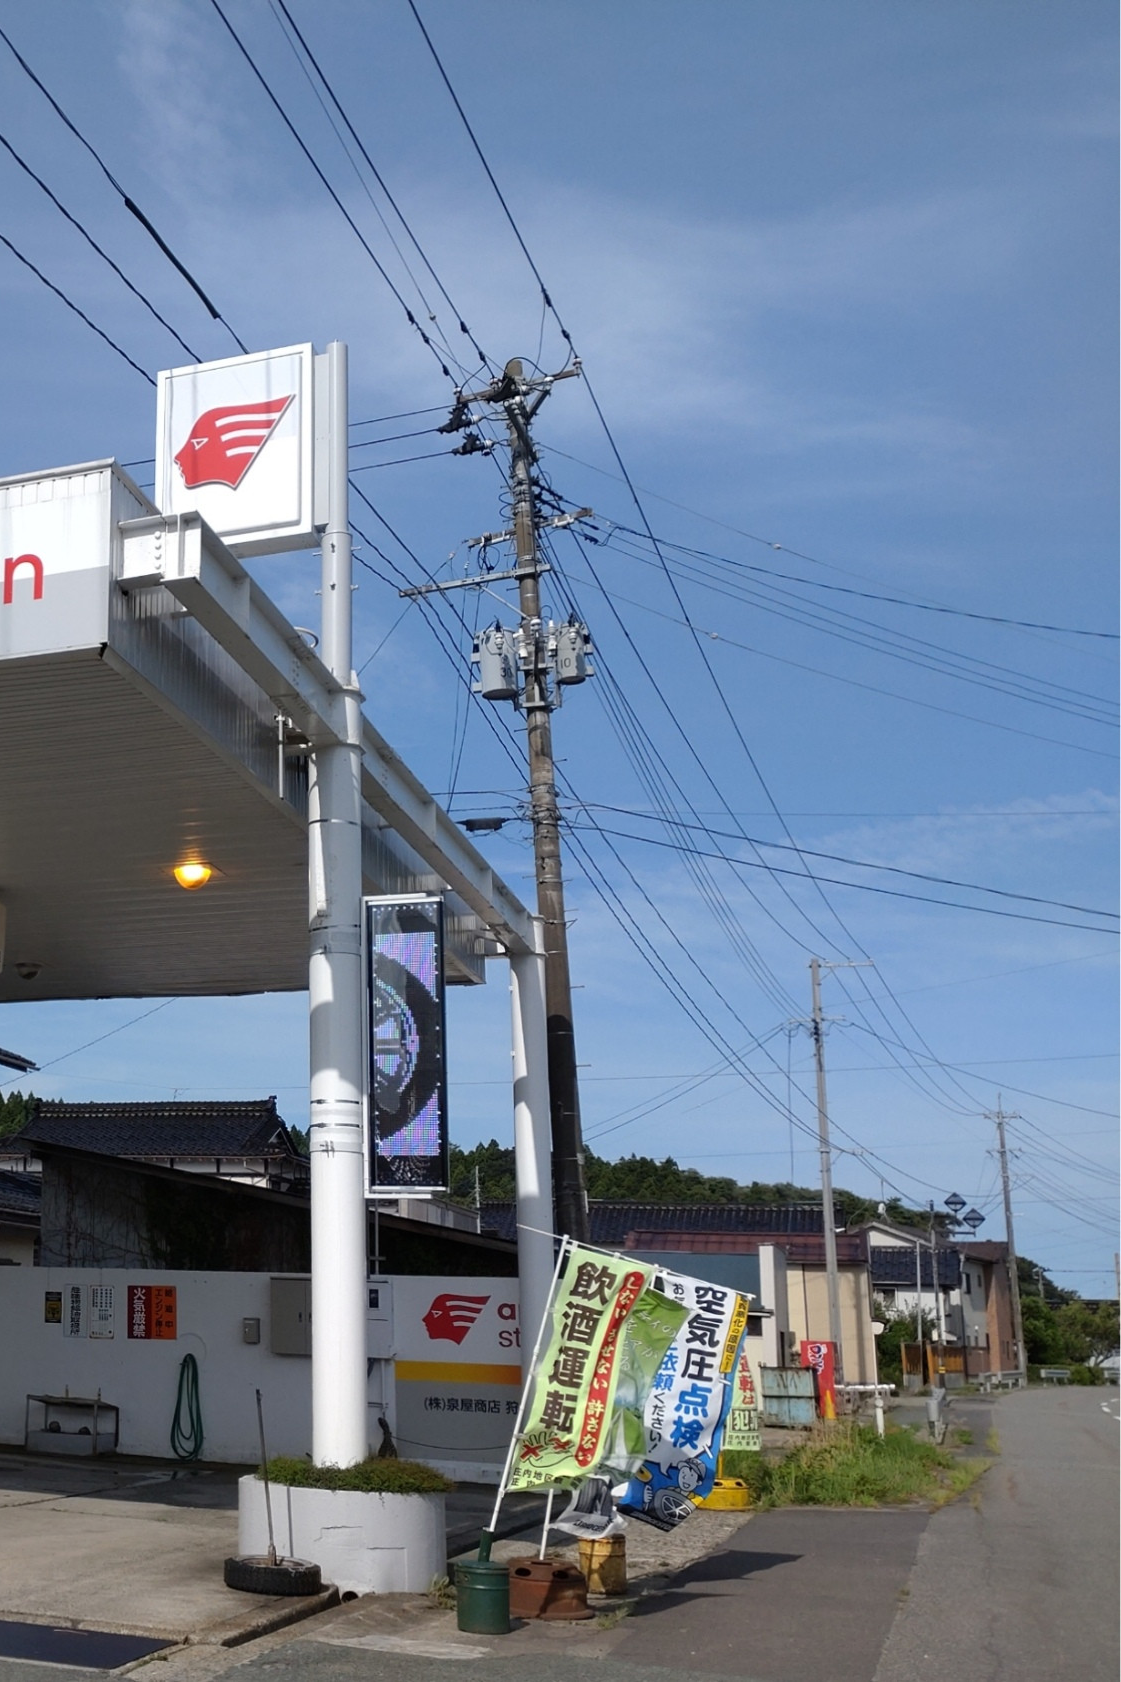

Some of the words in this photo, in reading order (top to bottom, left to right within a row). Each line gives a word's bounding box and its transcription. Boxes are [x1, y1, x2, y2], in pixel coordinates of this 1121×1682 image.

[133, 1287, 146, 1338] 火気厳禁
[539, 1261, 617, 1435] 飲酒運転
[615, 1276, 639, 1319] しない
[669, 1285, 728, 1451] 空気圧点検
